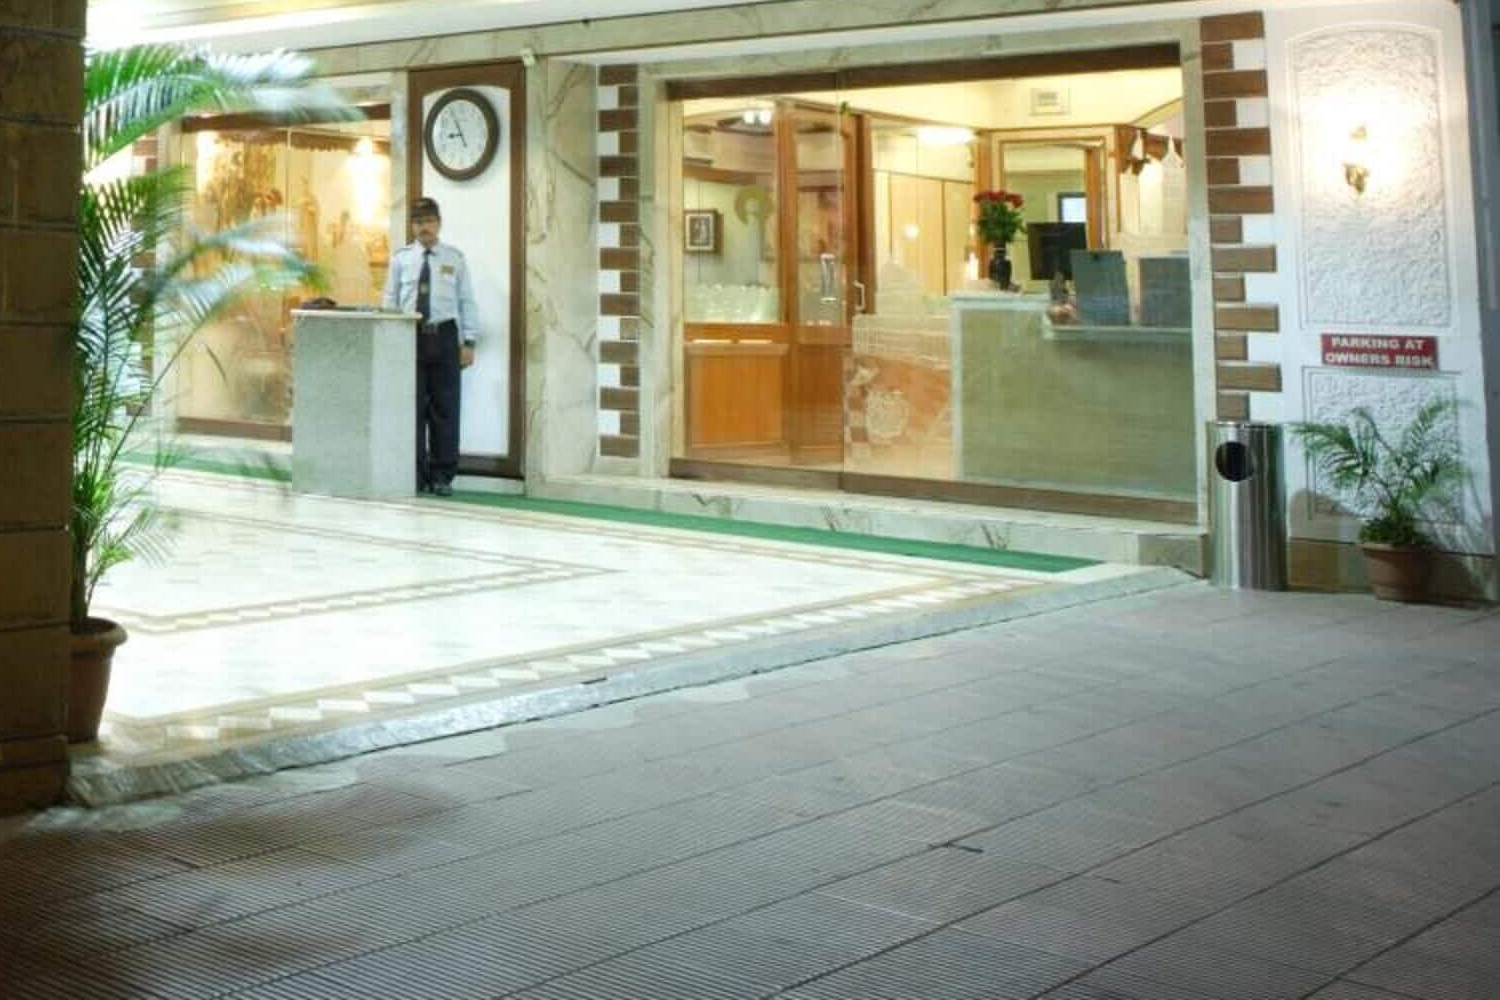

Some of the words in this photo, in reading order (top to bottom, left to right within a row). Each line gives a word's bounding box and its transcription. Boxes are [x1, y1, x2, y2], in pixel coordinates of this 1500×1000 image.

[1331, 336, 1399, 349] PARKING
[1404, 338, 1426, 350] AT
[1325, 352, 1390, 365] OWNERS
[1395, 355, 1434, 368] RISK
